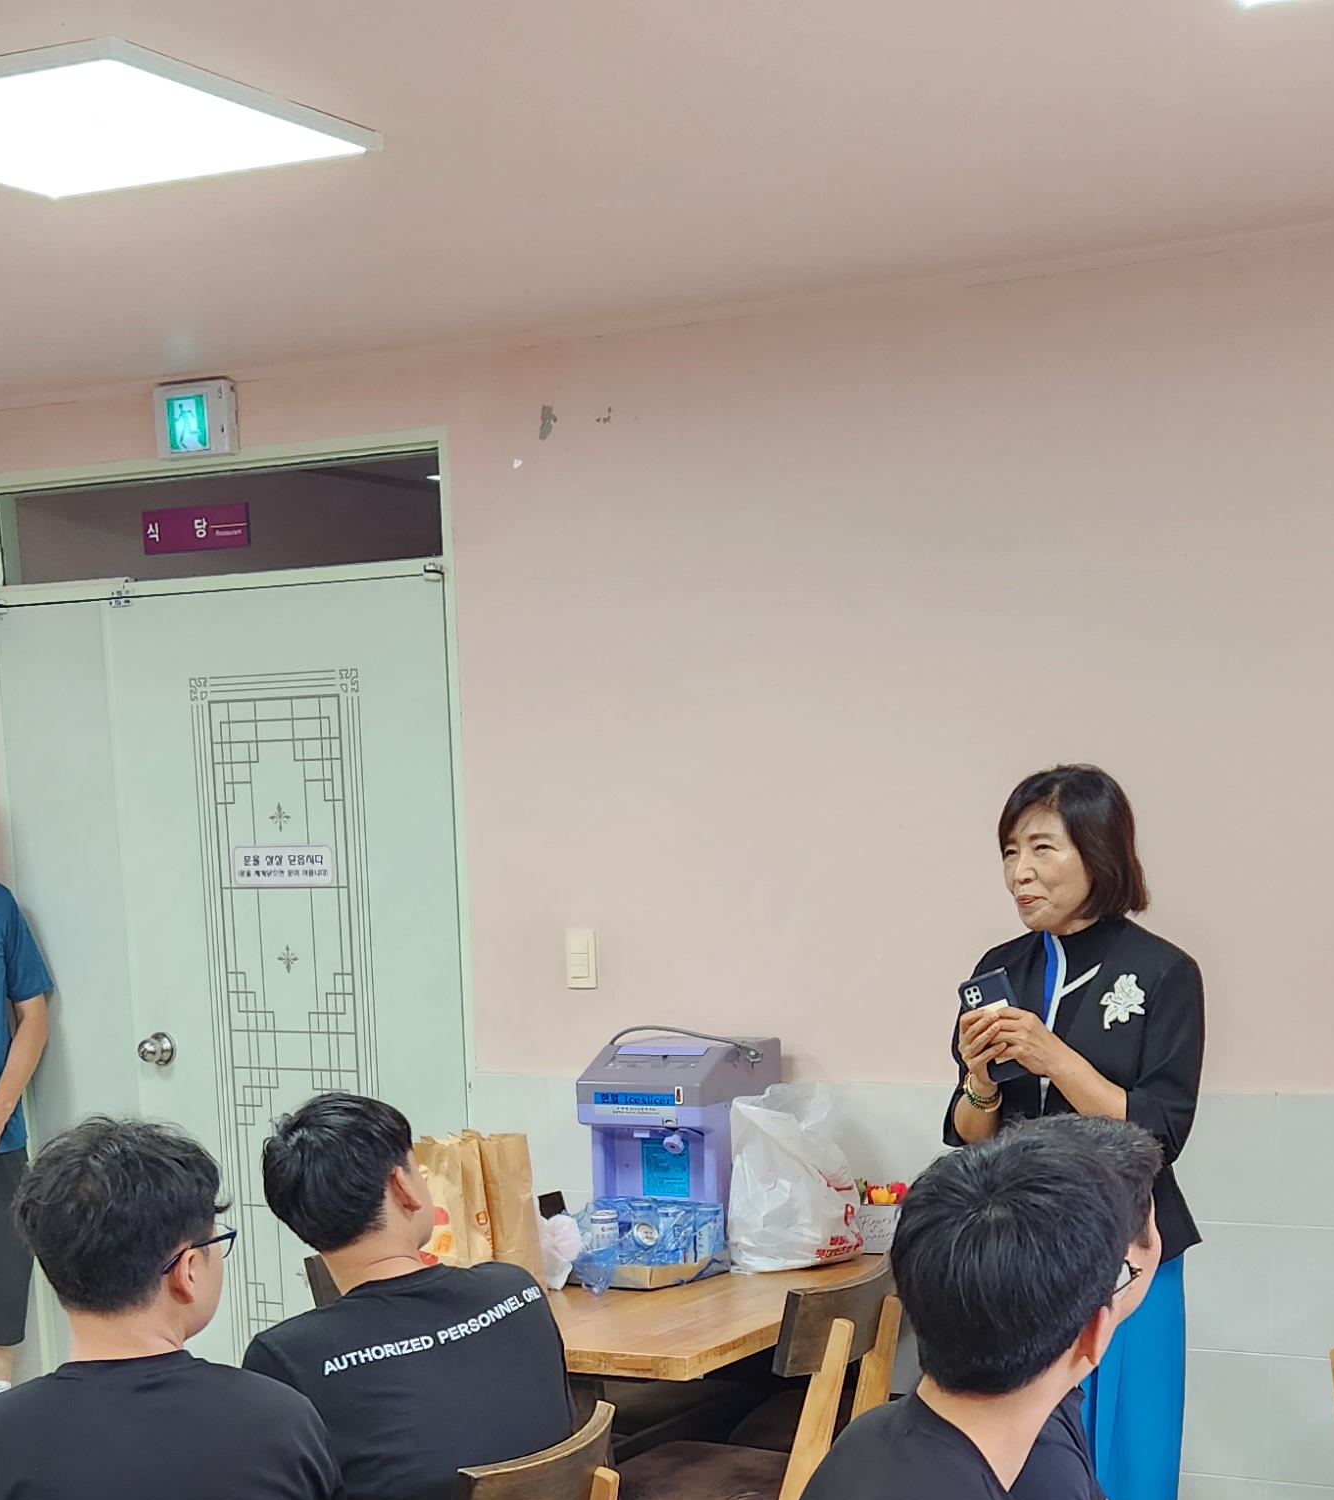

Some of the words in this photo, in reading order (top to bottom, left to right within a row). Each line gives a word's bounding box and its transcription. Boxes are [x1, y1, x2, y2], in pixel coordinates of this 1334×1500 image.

[243, 855, 260, 866] 문을
[265, 855, 283, 866] 살살
[323, 1335, 434, 1376] AUTHORIZED
[437, 1295, 524, 1345] PERSONNEL
[523, 1286, 541, 1303] ONLY
